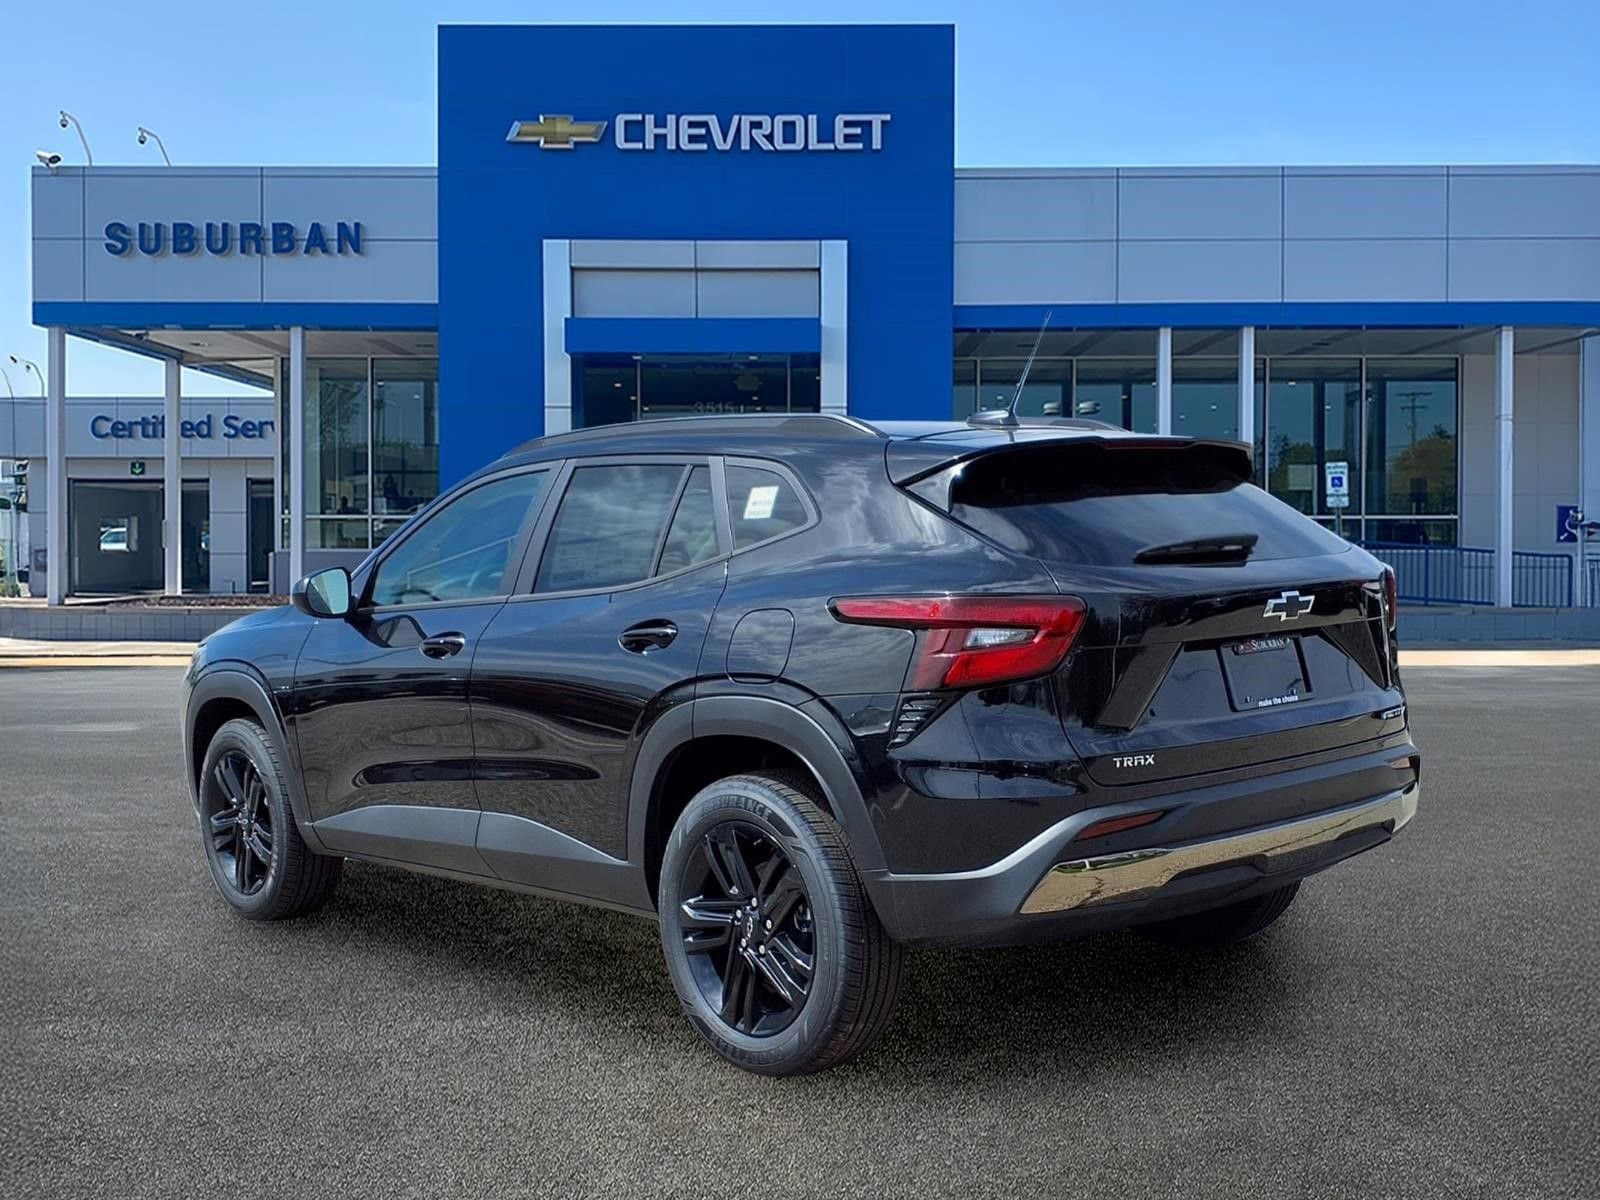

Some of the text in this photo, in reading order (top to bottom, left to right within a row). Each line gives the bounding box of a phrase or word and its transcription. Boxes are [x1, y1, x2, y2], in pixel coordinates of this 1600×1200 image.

[614, 113, 891, 152] CHEVROLET
[104, 220, 363, 257] SUBURBAN
[1112, 754, 1155, 768] TRAX
